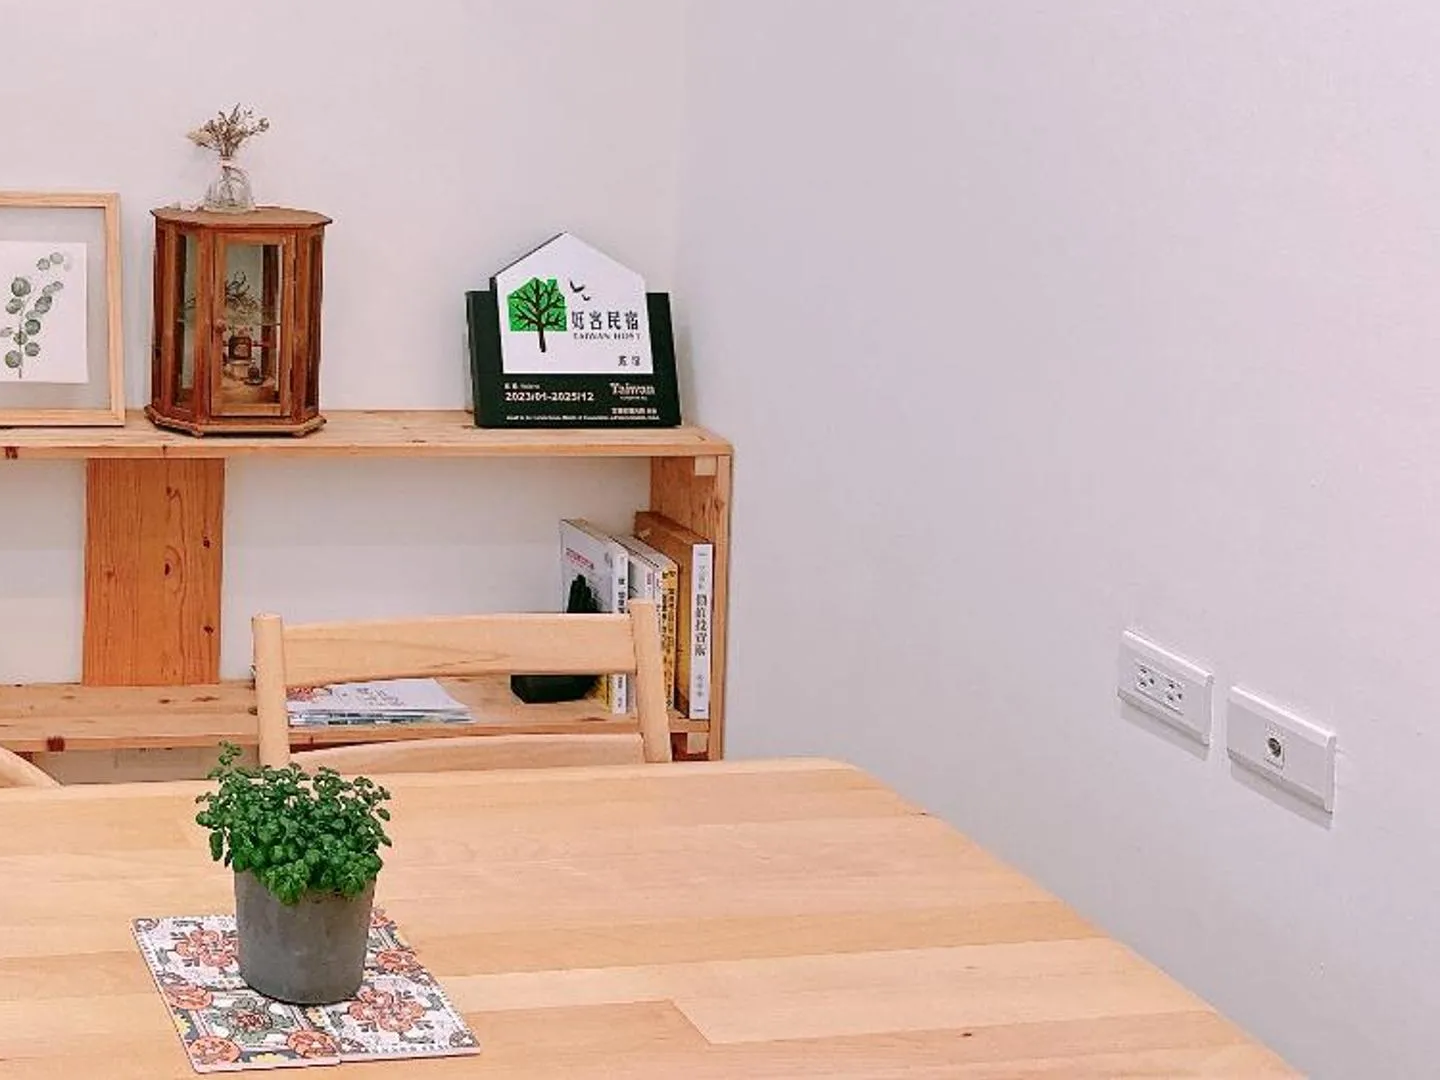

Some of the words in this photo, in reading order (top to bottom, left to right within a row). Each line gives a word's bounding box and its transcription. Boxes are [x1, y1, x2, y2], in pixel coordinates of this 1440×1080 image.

[571, 309, 639, 330] 好客民宿
[573, 332, 610, 340] TAIWAN
[609, 382, 656, 396] Taiwan
